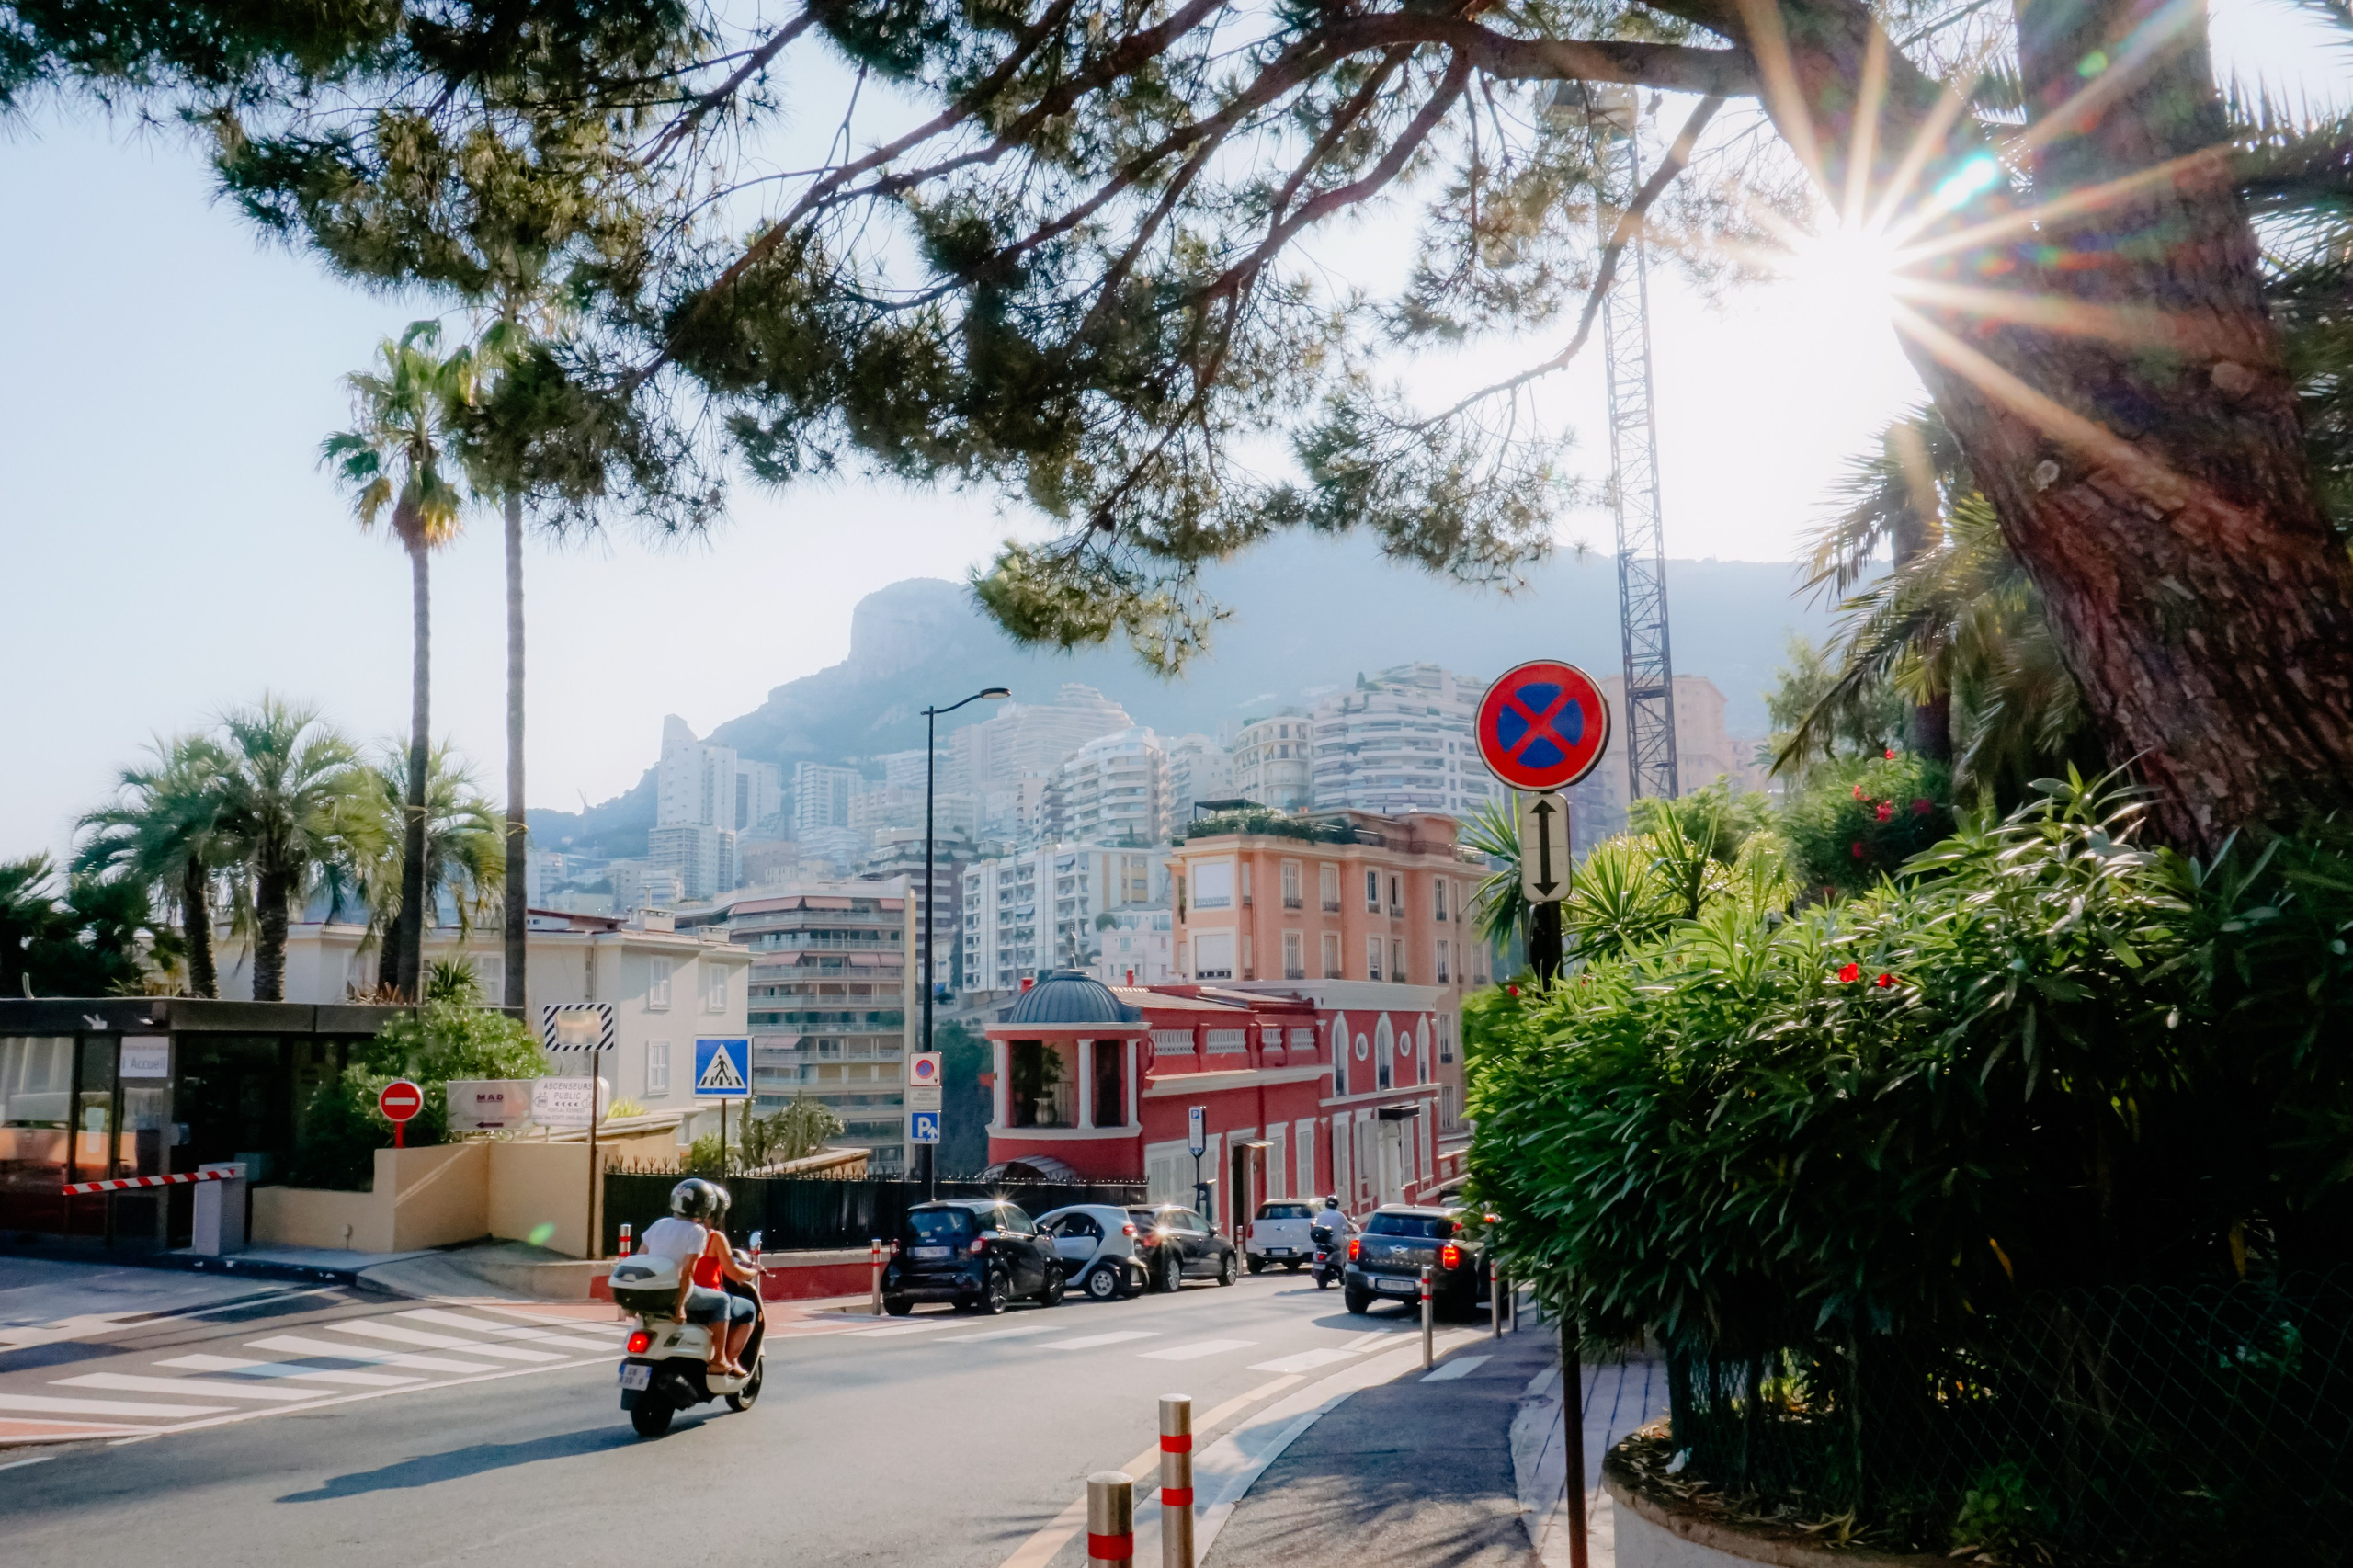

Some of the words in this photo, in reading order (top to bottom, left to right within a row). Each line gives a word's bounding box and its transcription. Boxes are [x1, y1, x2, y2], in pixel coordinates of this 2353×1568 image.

[130, 1057, 166, 1070] Accueil
[543, 1083, 593, 1091] ASCENSEURS
[476, 1094, 504, 1103] MAD
[553, 1092, 581, 1100] PUBLIC
[917, 1117, 932, 1138] P
